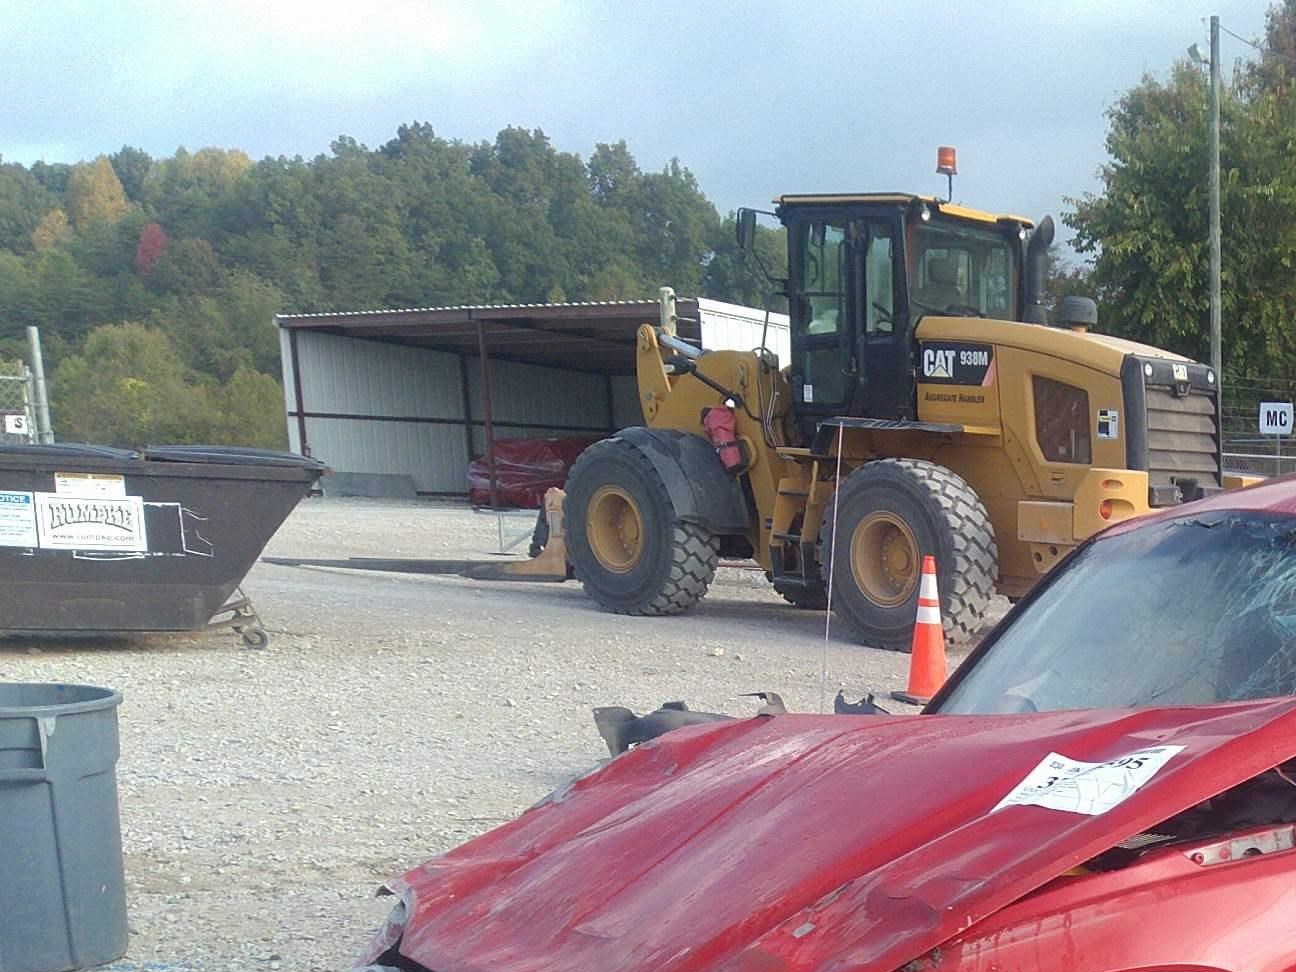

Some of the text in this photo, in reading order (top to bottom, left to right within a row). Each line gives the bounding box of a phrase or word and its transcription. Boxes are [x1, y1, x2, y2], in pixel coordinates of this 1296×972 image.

[923, 349, 989, 377] CAT 938M
[1266, 410, 1288, 427] MC
[48, 503, 133, 531] RUMPKE
